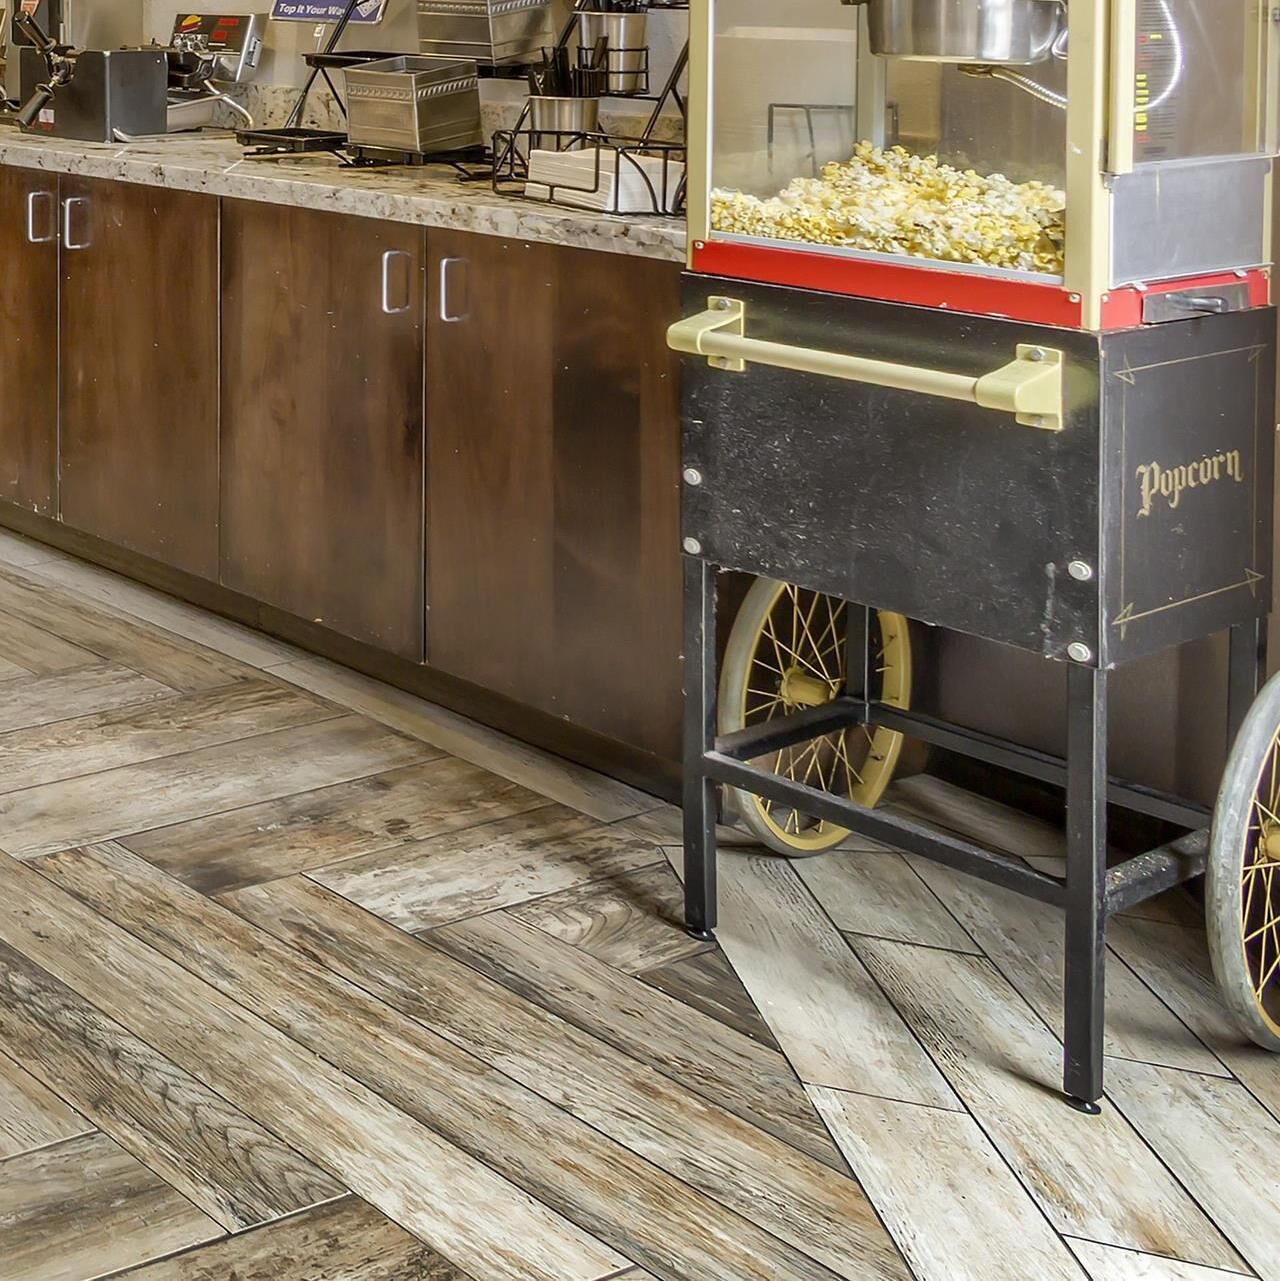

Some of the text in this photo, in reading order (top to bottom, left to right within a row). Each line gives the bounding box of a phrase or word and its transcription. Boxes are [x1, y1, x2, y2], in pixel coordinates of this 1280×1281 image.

[279, 3, 296, 15] Top
[296, 3, 305, 14] It
[306, 5, 328, 15] Your
[1135, 449, 1244, 519] Popcorn
